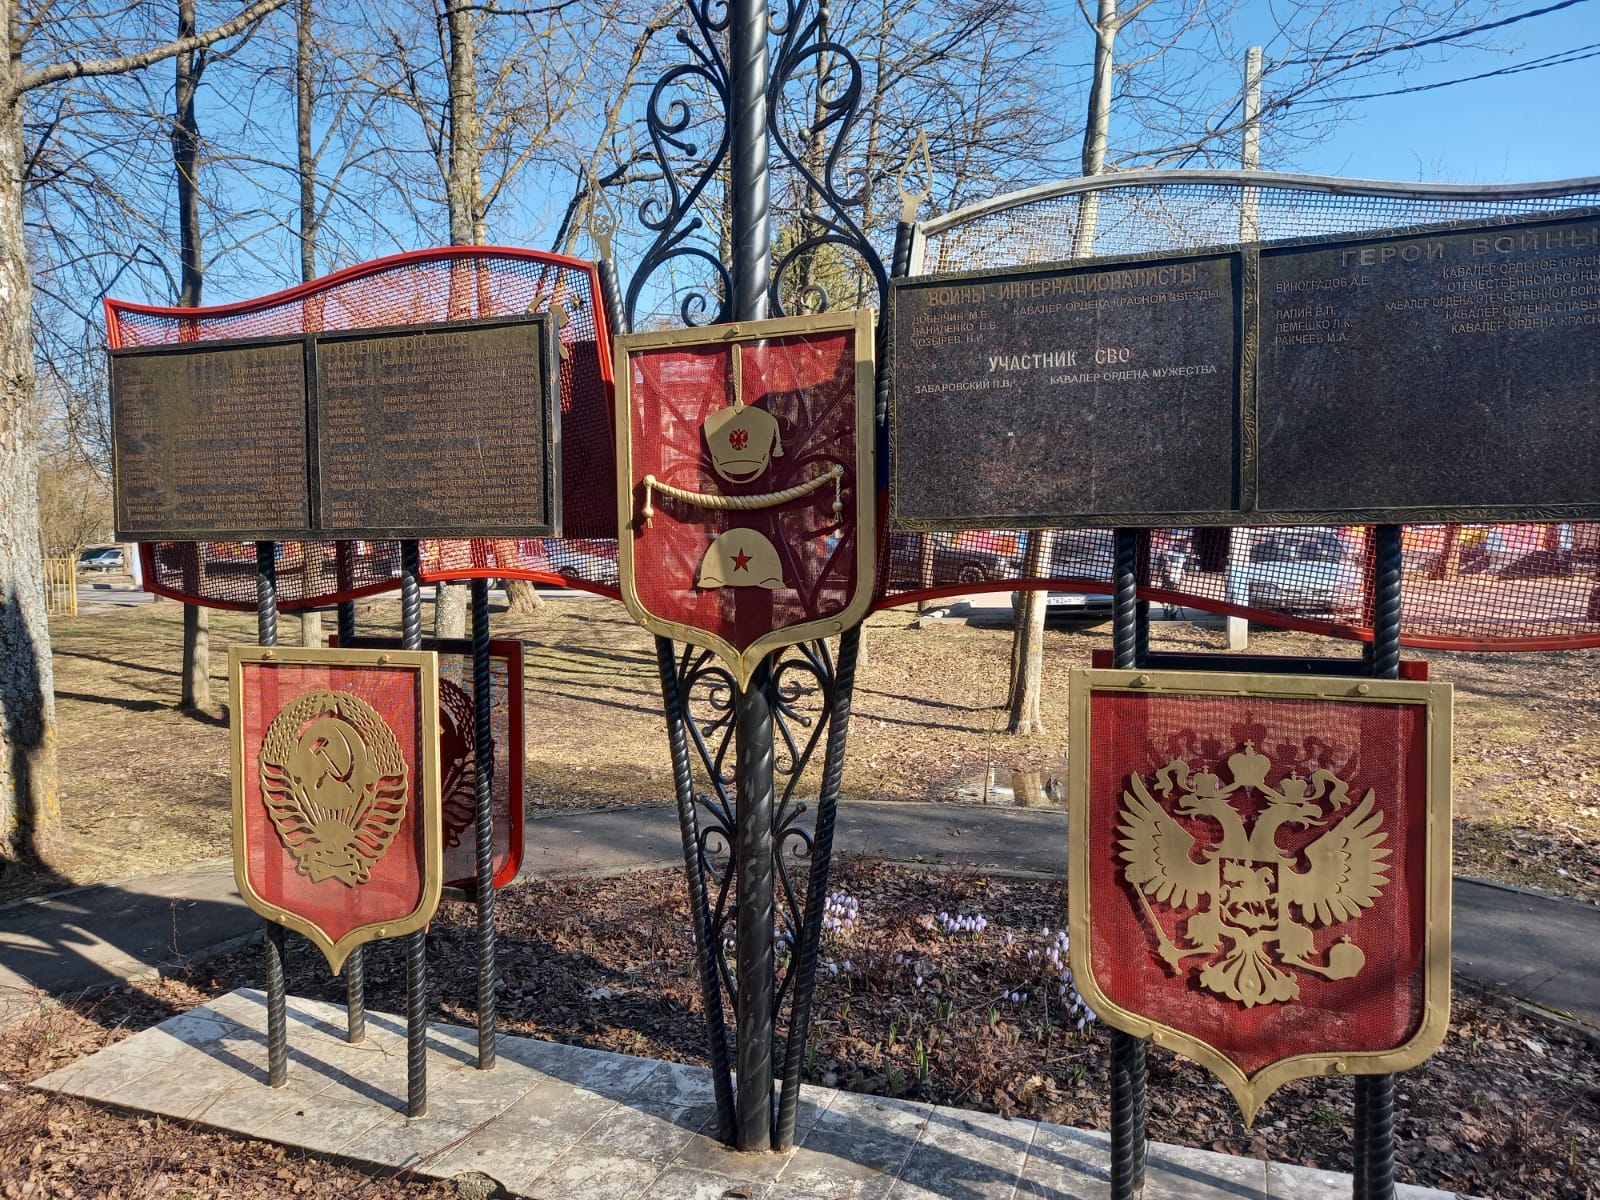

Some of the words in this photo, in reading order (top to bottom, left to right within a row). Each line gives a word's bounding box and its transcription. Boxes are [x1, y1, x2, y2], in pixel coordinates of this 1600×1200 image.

[1342, 241, 1444, 267] ГЕРОИ
[1472, 227, 1600, 255] ВОЙНЫ
[1443, 264, 1497, 278] КАВАЛЕР
[1500, 259, 1558, 274] ОРДЕНОВ
[928, 286, 986, 306] ВОИНЫ
[1000, 264, 1197, 300] ИНТЕРНАЦИОНАЛИСТЫ
[1276, 277, 1347, 293] ВИНОГРАДОВ
[1013, 303, 1062, 316] КАВАЛЕР
[1066, 299, 1110, 311] ОРДЕНА
[1170, 289, 1220, 302] ЗВЕЗДЫ
[1384, 299, 1429, 311] КАВАЛЕР
[1432, 295, 1474, 309] ОРДЕНА
[1446, 307, 1499, 321] КАВАЛЕР
[1503, 302, 1552, 317] ОРДЕНА
[912, 311, 964, 326] ДОБЫЧИН
[1451, 321, 1505, 335] КАВАЛЕР
[1508, 316, 1557, 331] ОРДЕНА
[912, 322, 974, 337] ДАНИЛЕНКО
[1275, 333, 1324, 346] РАКЧЕЕВ
[989, 350, 1078, 372] УЧАСТНИК
[1095, 346, 1130, 364] СВО
[1050, 373, 1100, 385] КАВАЛЕР
[1103, 369, 1149, 381] ОРДЕНА
[1152, 364, 1217, 378] МУЖЕСТВА
[915, 378, 990, 394] ЗАБАРОВСКИЙ
